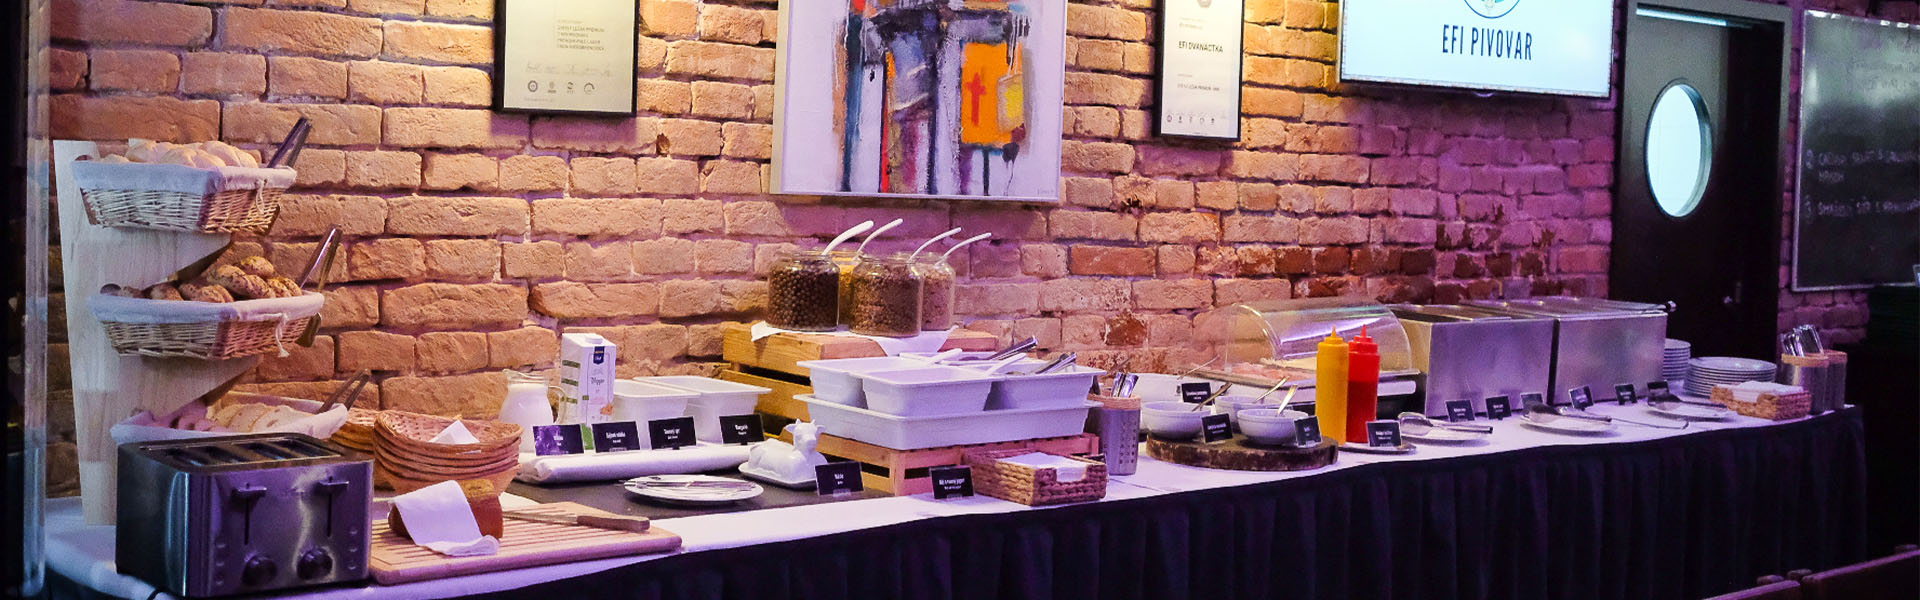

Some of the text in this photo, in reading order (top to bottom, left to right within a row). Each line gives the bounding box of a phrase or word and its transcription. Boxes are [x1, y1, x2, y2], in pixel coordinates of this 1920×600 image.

[1178, 40, 1188, 49] EFI
[1442, 24, 1532, 60] EFI PIVOVAR
